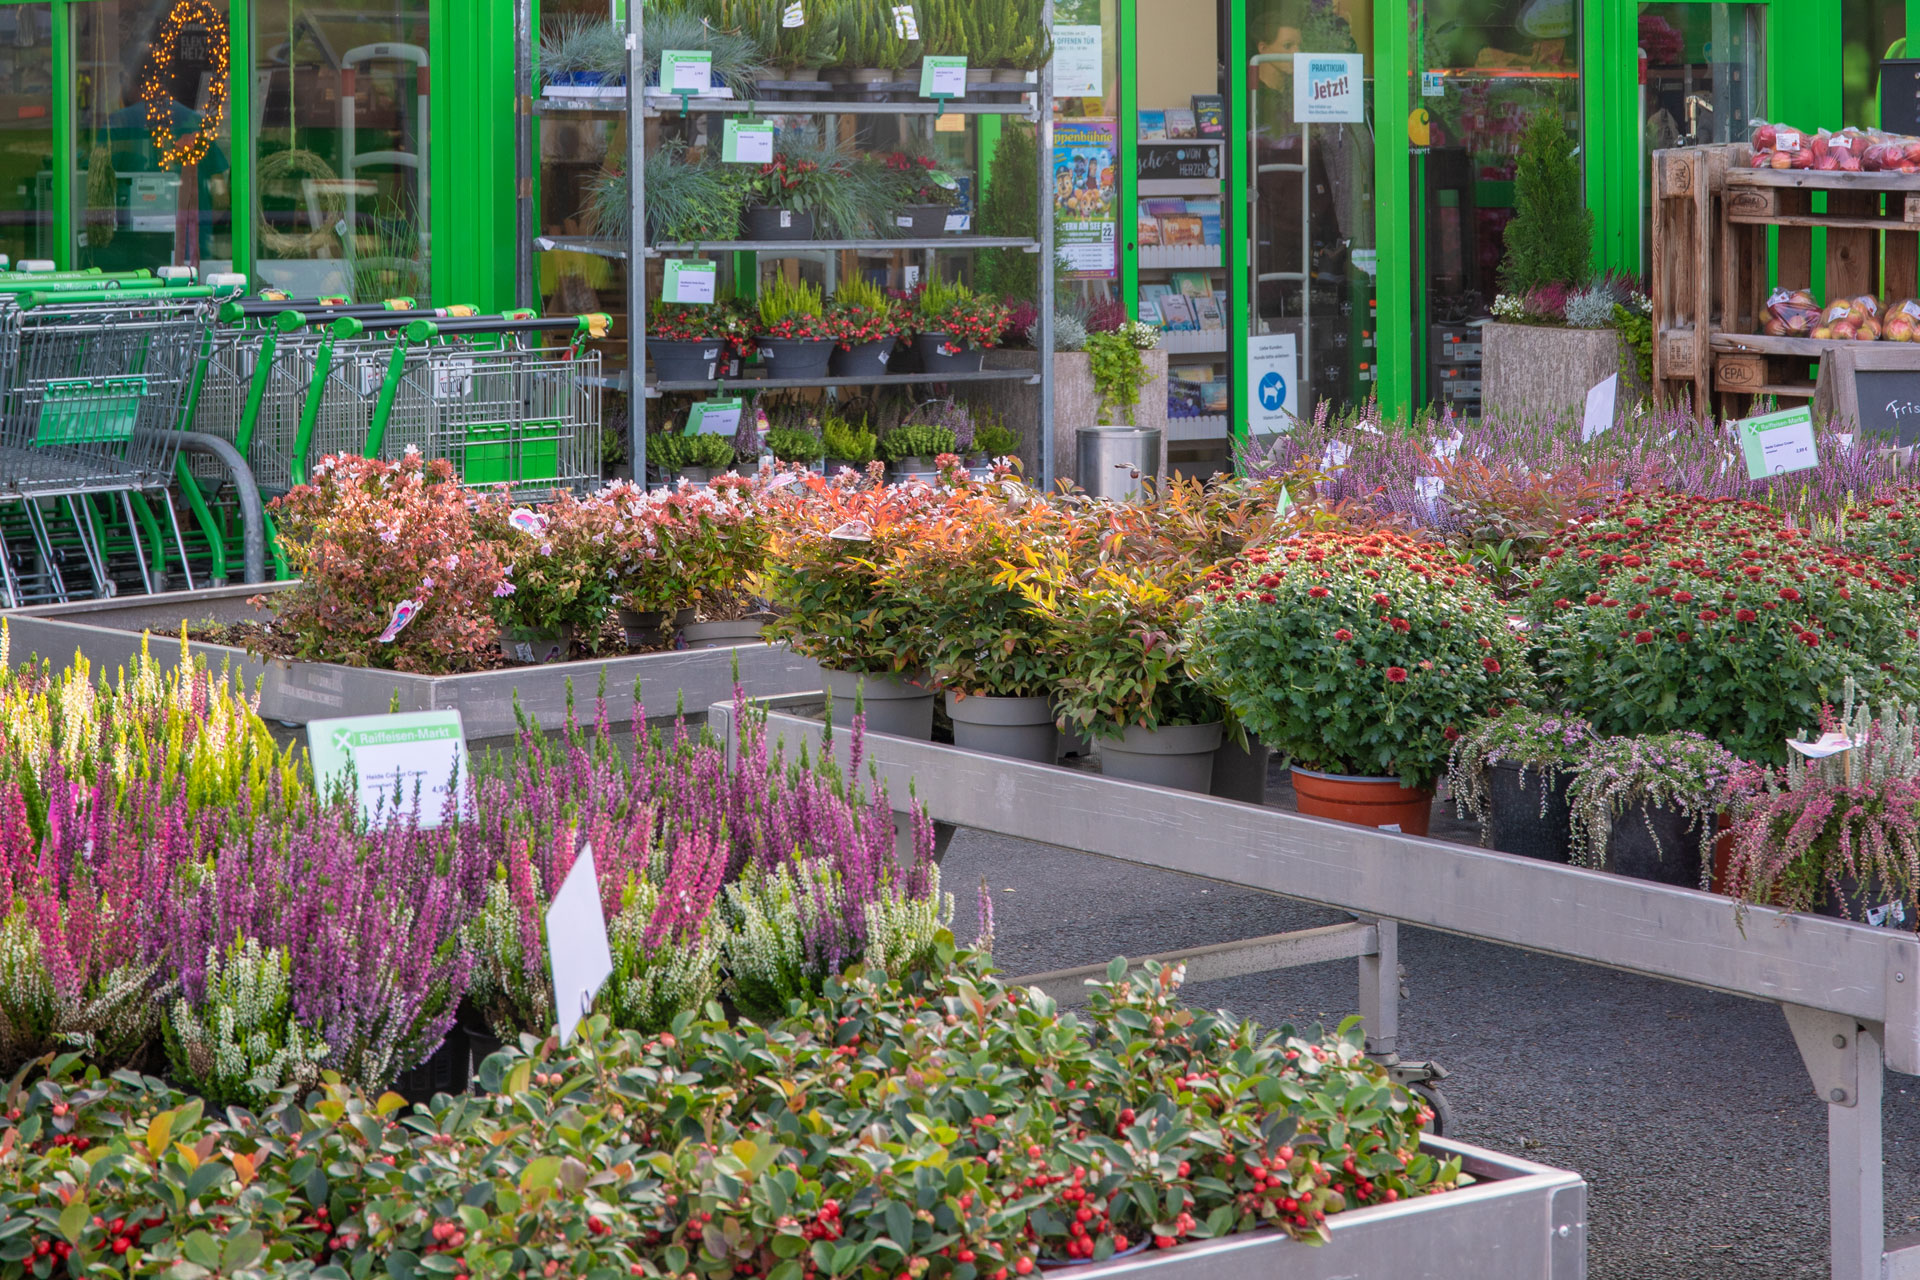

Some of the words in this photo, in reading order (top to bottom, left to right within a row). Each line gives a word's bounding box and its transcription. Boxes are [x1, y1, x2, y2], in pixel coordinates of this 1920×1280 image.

[1083, 36, 1095, 44] TÜR
[1311, 63, 1345, 72] PRAKTIKUM
[1314, 76, 1349, 100] Jetzt!
[1185, 148, 1201, 159] VON
[1180, 162, 1208, 176] HERZEN
[1724, 367, 1748, 379] EPAL
[1760, 416, 1804, 430] Raiffeisen-Markt
[360, 727, 450, 744] Raiffeisen-Markt
